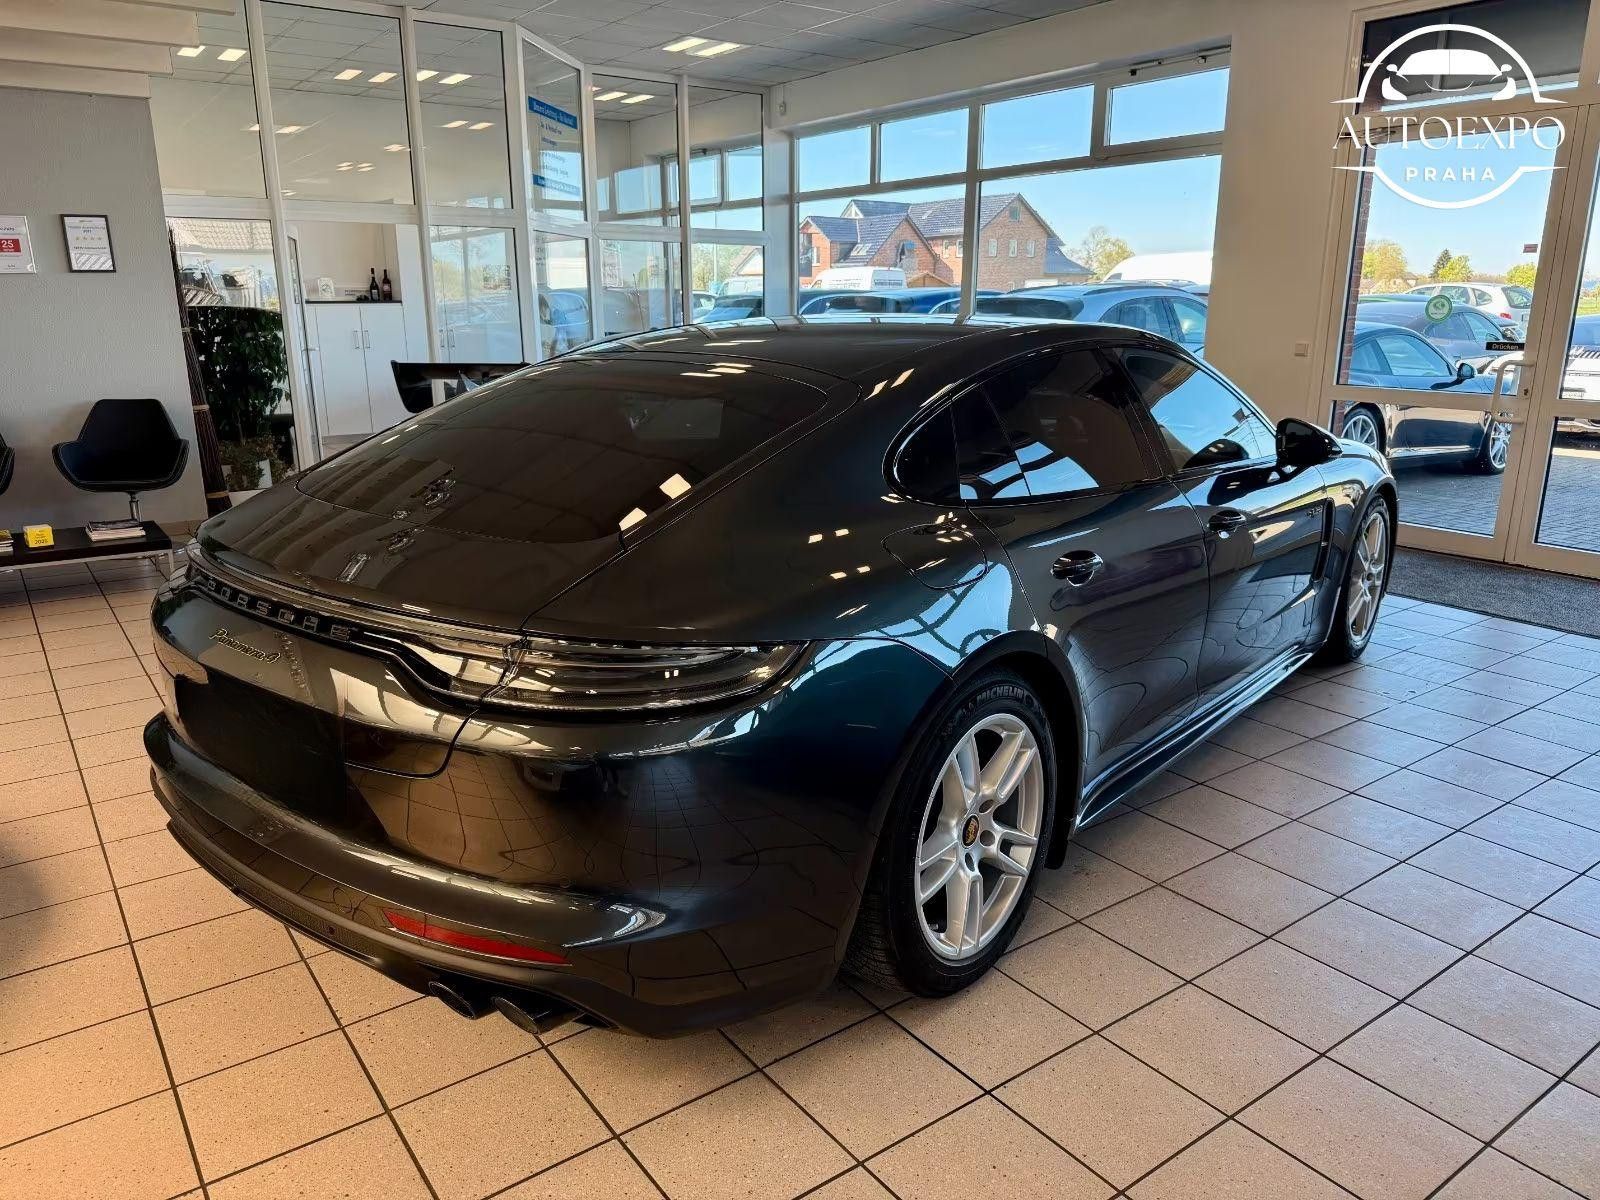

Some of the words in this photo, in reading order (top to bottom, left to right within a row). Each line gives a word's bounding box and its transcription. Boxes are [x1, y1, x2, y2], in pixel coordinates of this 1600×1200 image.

[1491, 343, 1519, 351] Drücken
[208, 628, 266, 661] Panamera
[976, 685, 1027, 702] MICHELIN
